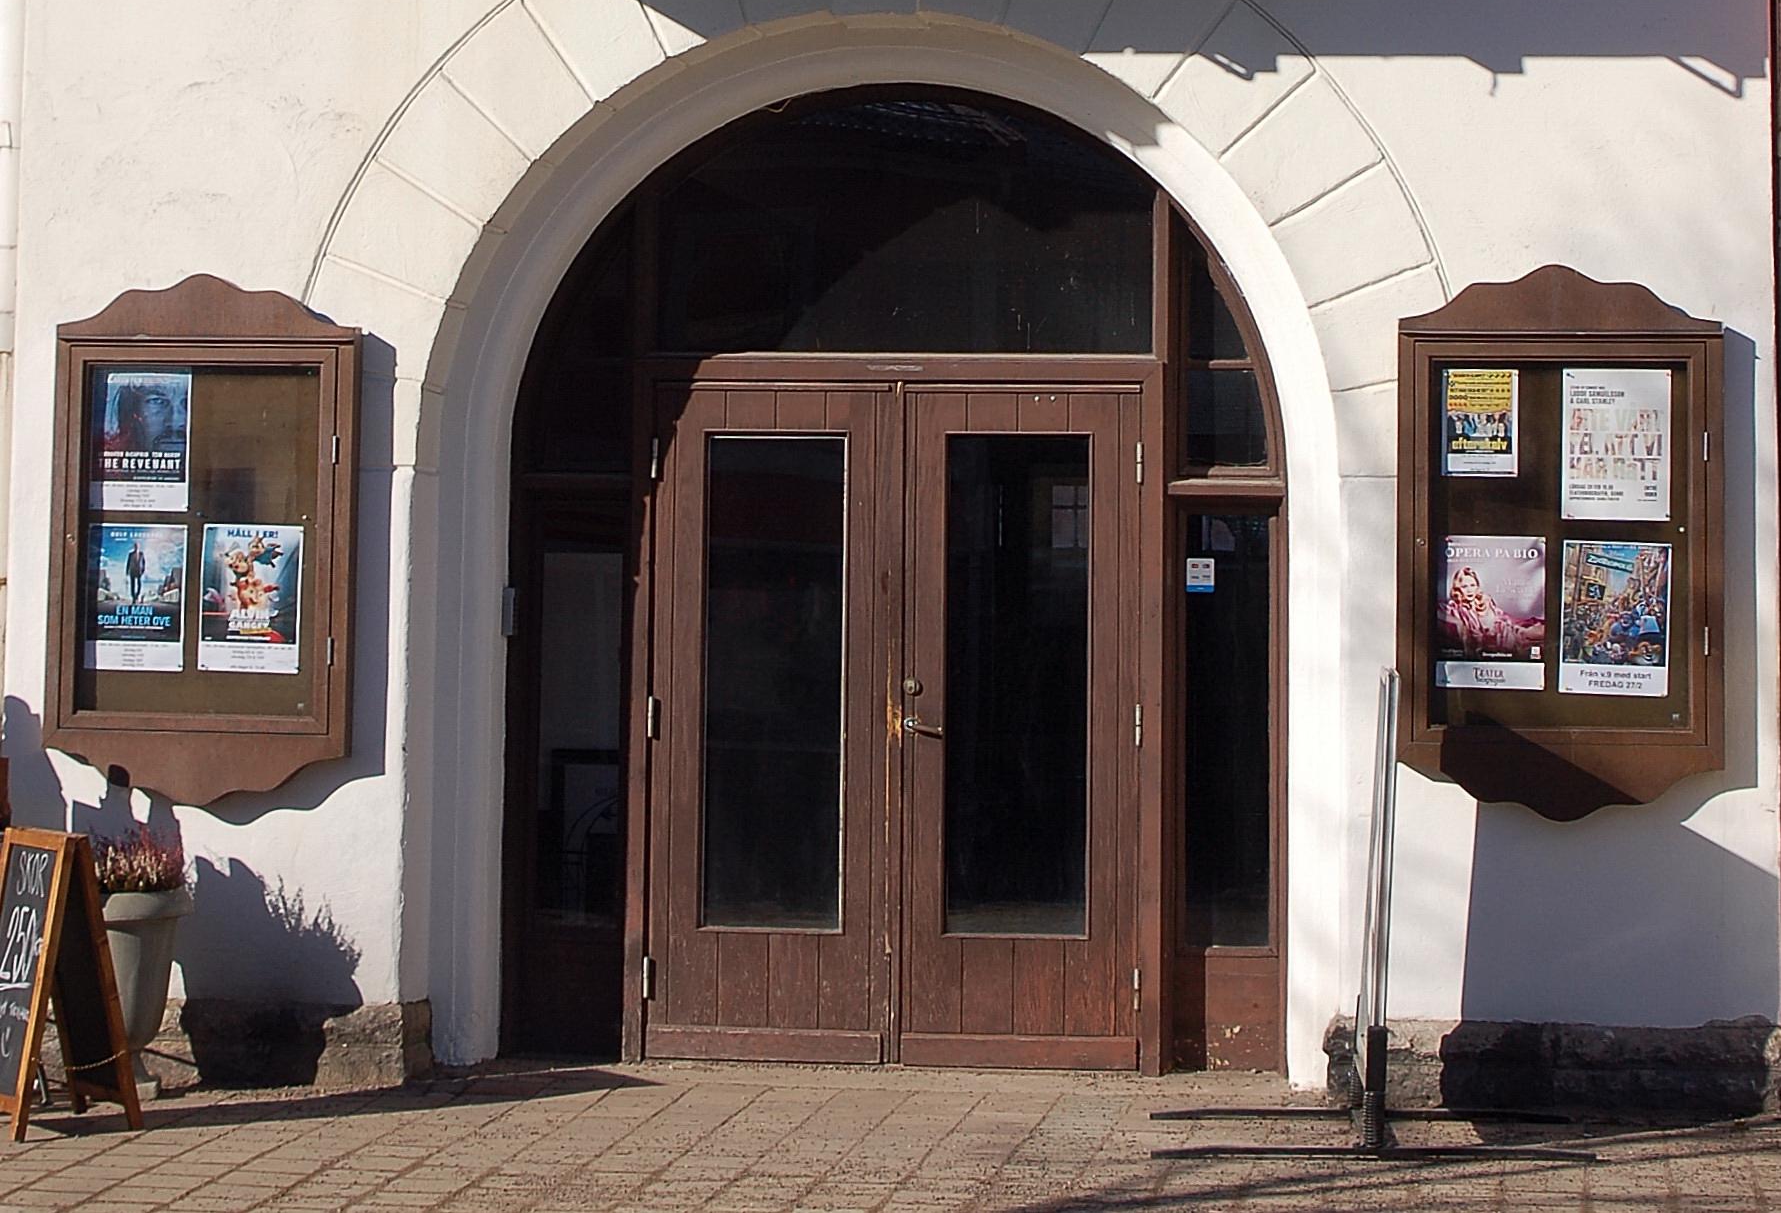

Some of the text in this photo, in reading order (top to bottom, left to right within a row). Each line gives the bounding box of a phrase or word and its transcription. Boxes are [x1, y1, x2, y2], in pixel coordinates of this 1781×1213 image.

[122, 458, 181, 469] REVENANT
[1445, 548, 1490, 558] OPERA
[1513, 548, 1539, 559] BIO
[131, 605, 153, 616] MAN
[97, 614, 119, 625] SOM
[121, 615, 150, 626] HETER
